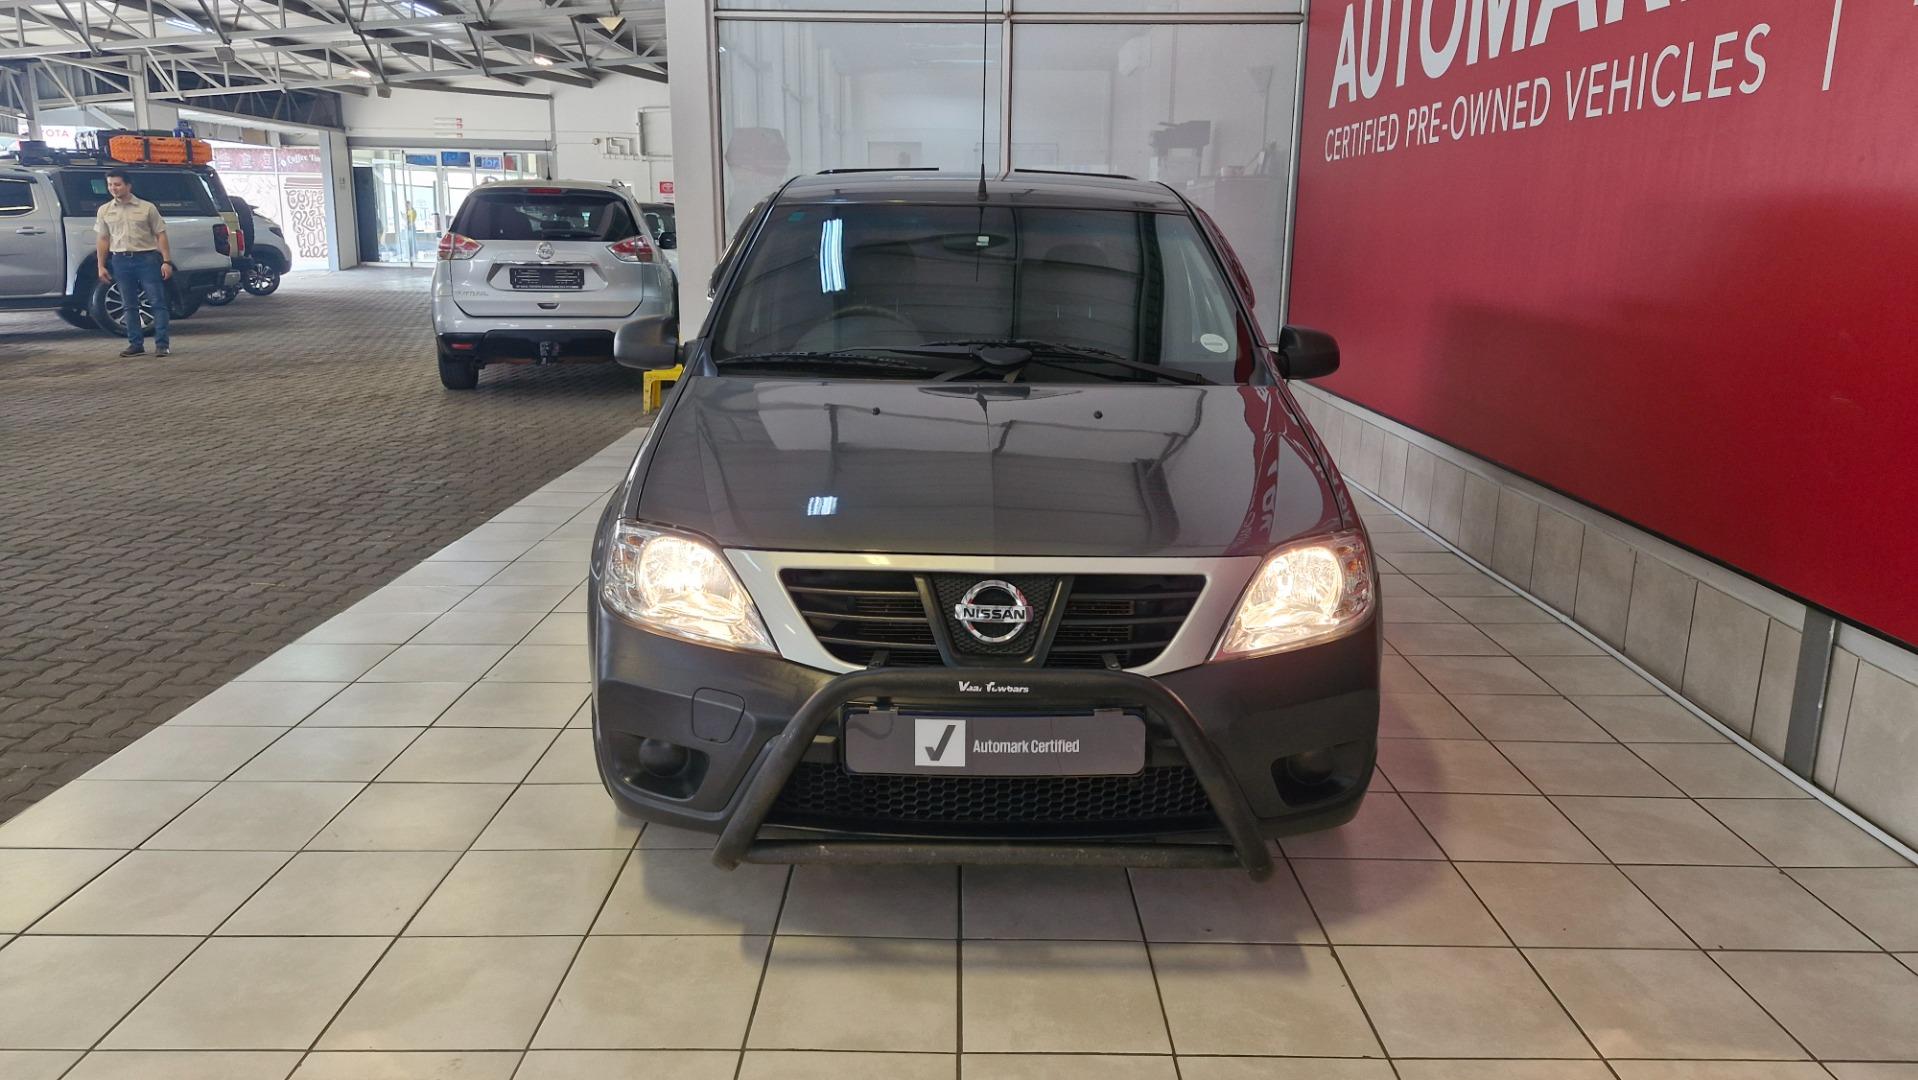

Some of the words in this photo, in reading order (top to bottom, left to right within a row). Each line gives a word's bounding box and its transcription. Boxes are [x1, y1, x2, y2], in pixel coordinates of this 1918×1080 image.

[1328, 0, 1687, 109] AUTO
[1325, 113, 1400, 163] CERTIFIED
[1405, 76, 1551, 148] PRE-OWNED
[1565, 22, 1771, 121] VEHICLES
[963, 607, 1025, 620] NISSAN
[973, 739, 1029, 754] Automark
[1030, 738, 1080, 754] Certified
